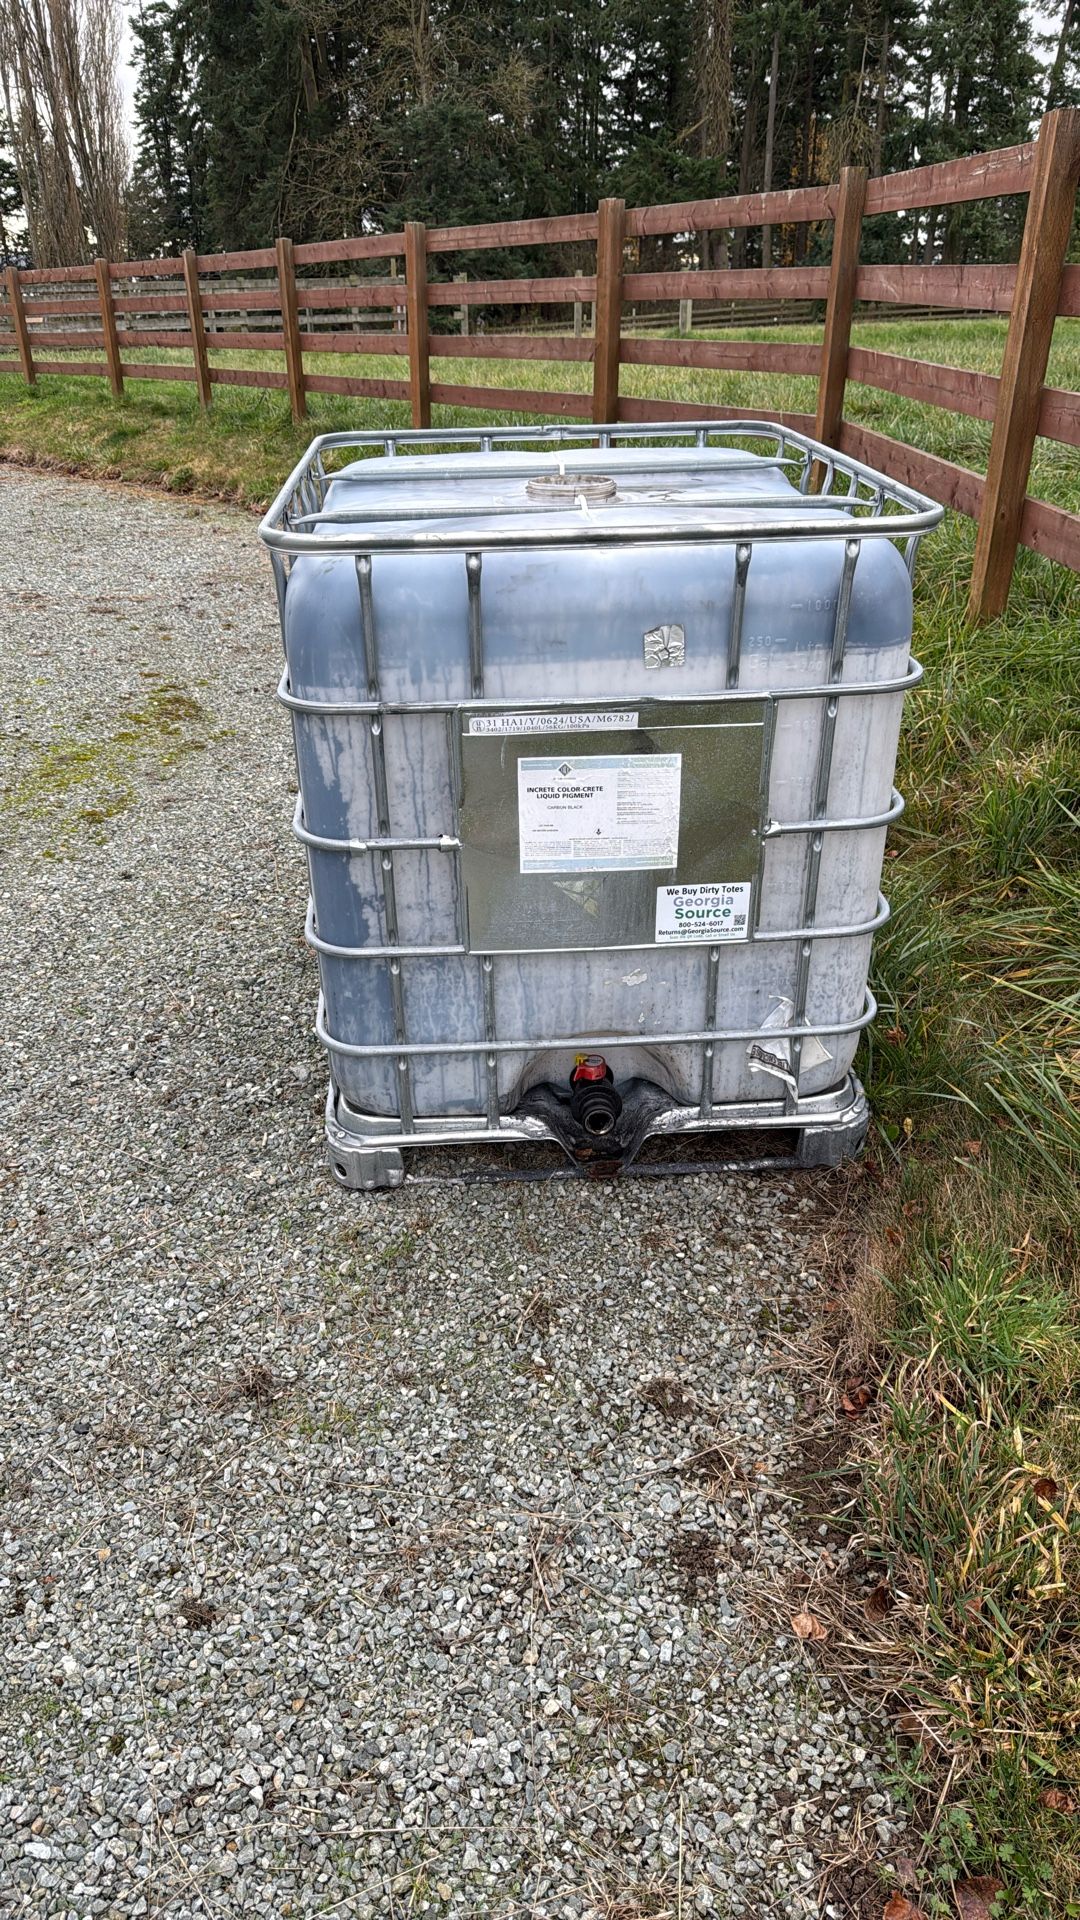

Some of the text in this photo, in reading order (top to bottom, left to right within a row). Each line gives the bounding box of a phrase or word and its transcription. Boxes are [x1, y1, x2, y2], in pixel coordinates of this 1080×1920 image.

[748, 635, 772, 647] 250
[666, 885, 744, 896] We Buy Dirty Totes
[673, 894, 734, 907] Georgia
[674, 908, 731, 919] Source
[678, 920, 724, 928] 800-524-6017
[658, 926, 744, 936] Returns@GeorgiaSource.com
